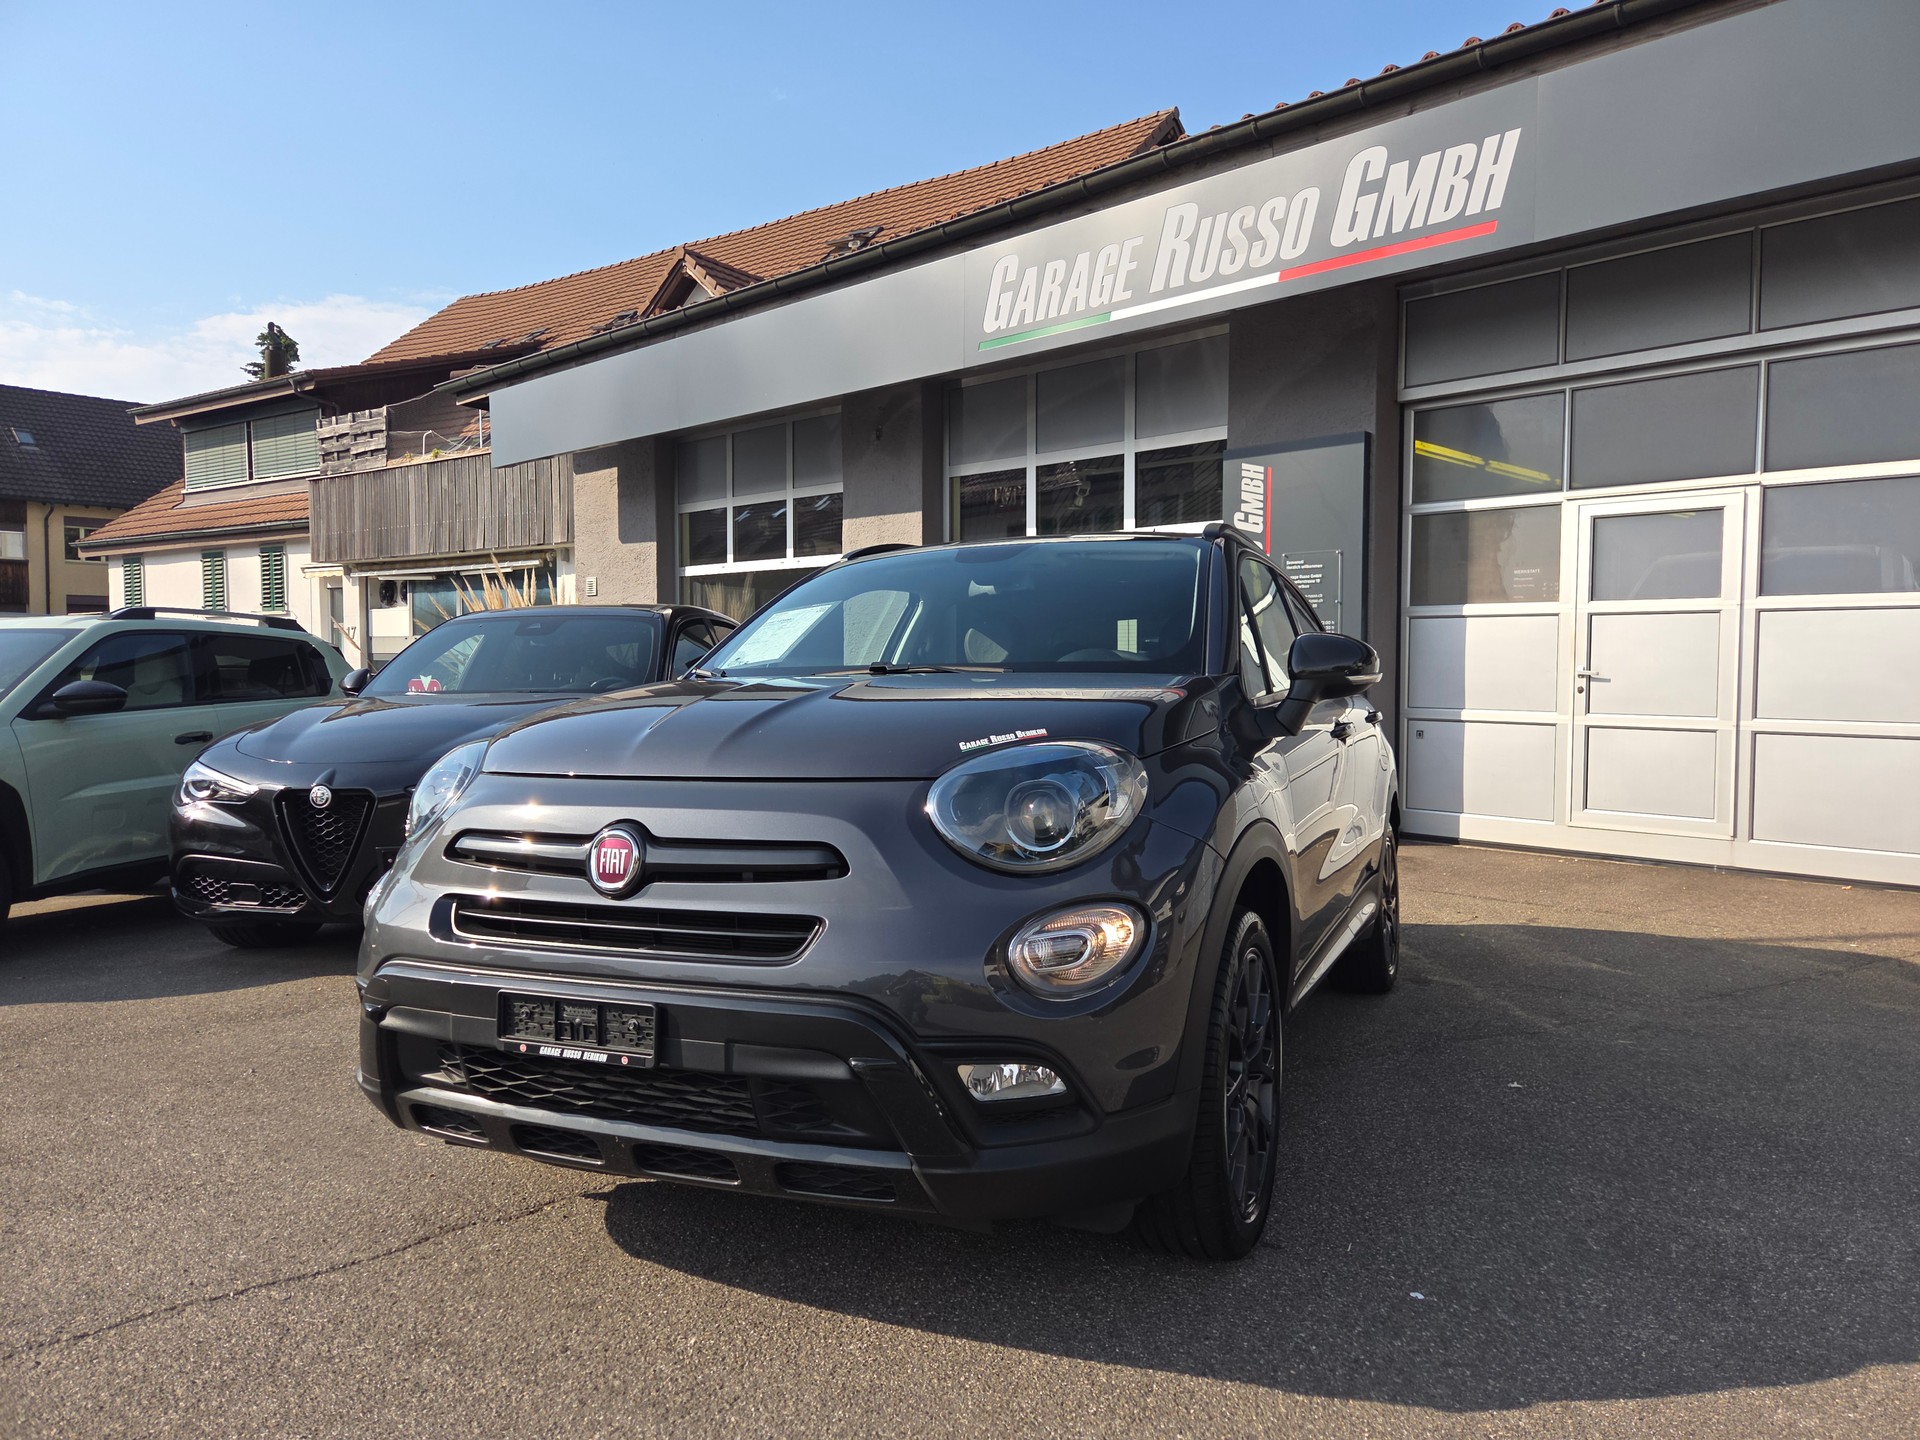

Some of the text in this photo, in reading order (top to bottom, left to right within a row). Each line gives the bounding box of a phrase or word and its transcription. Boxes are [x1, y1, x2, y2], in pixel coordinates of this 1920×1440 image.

[982, 128, 1521, 333] GARAGE RUSSO GMBH
[1233, 463, 1265, 534] GMBH
[959, 728, 1047, 751] GARAGE RUSSO BERIKON
[600, 848, 629, 874] FIAT
[539, 1046, 562, 1057] GARAGE
[563, 1049, 582, 1059] RUSSO
[582, 1051, 608, 1062] BERIKON
